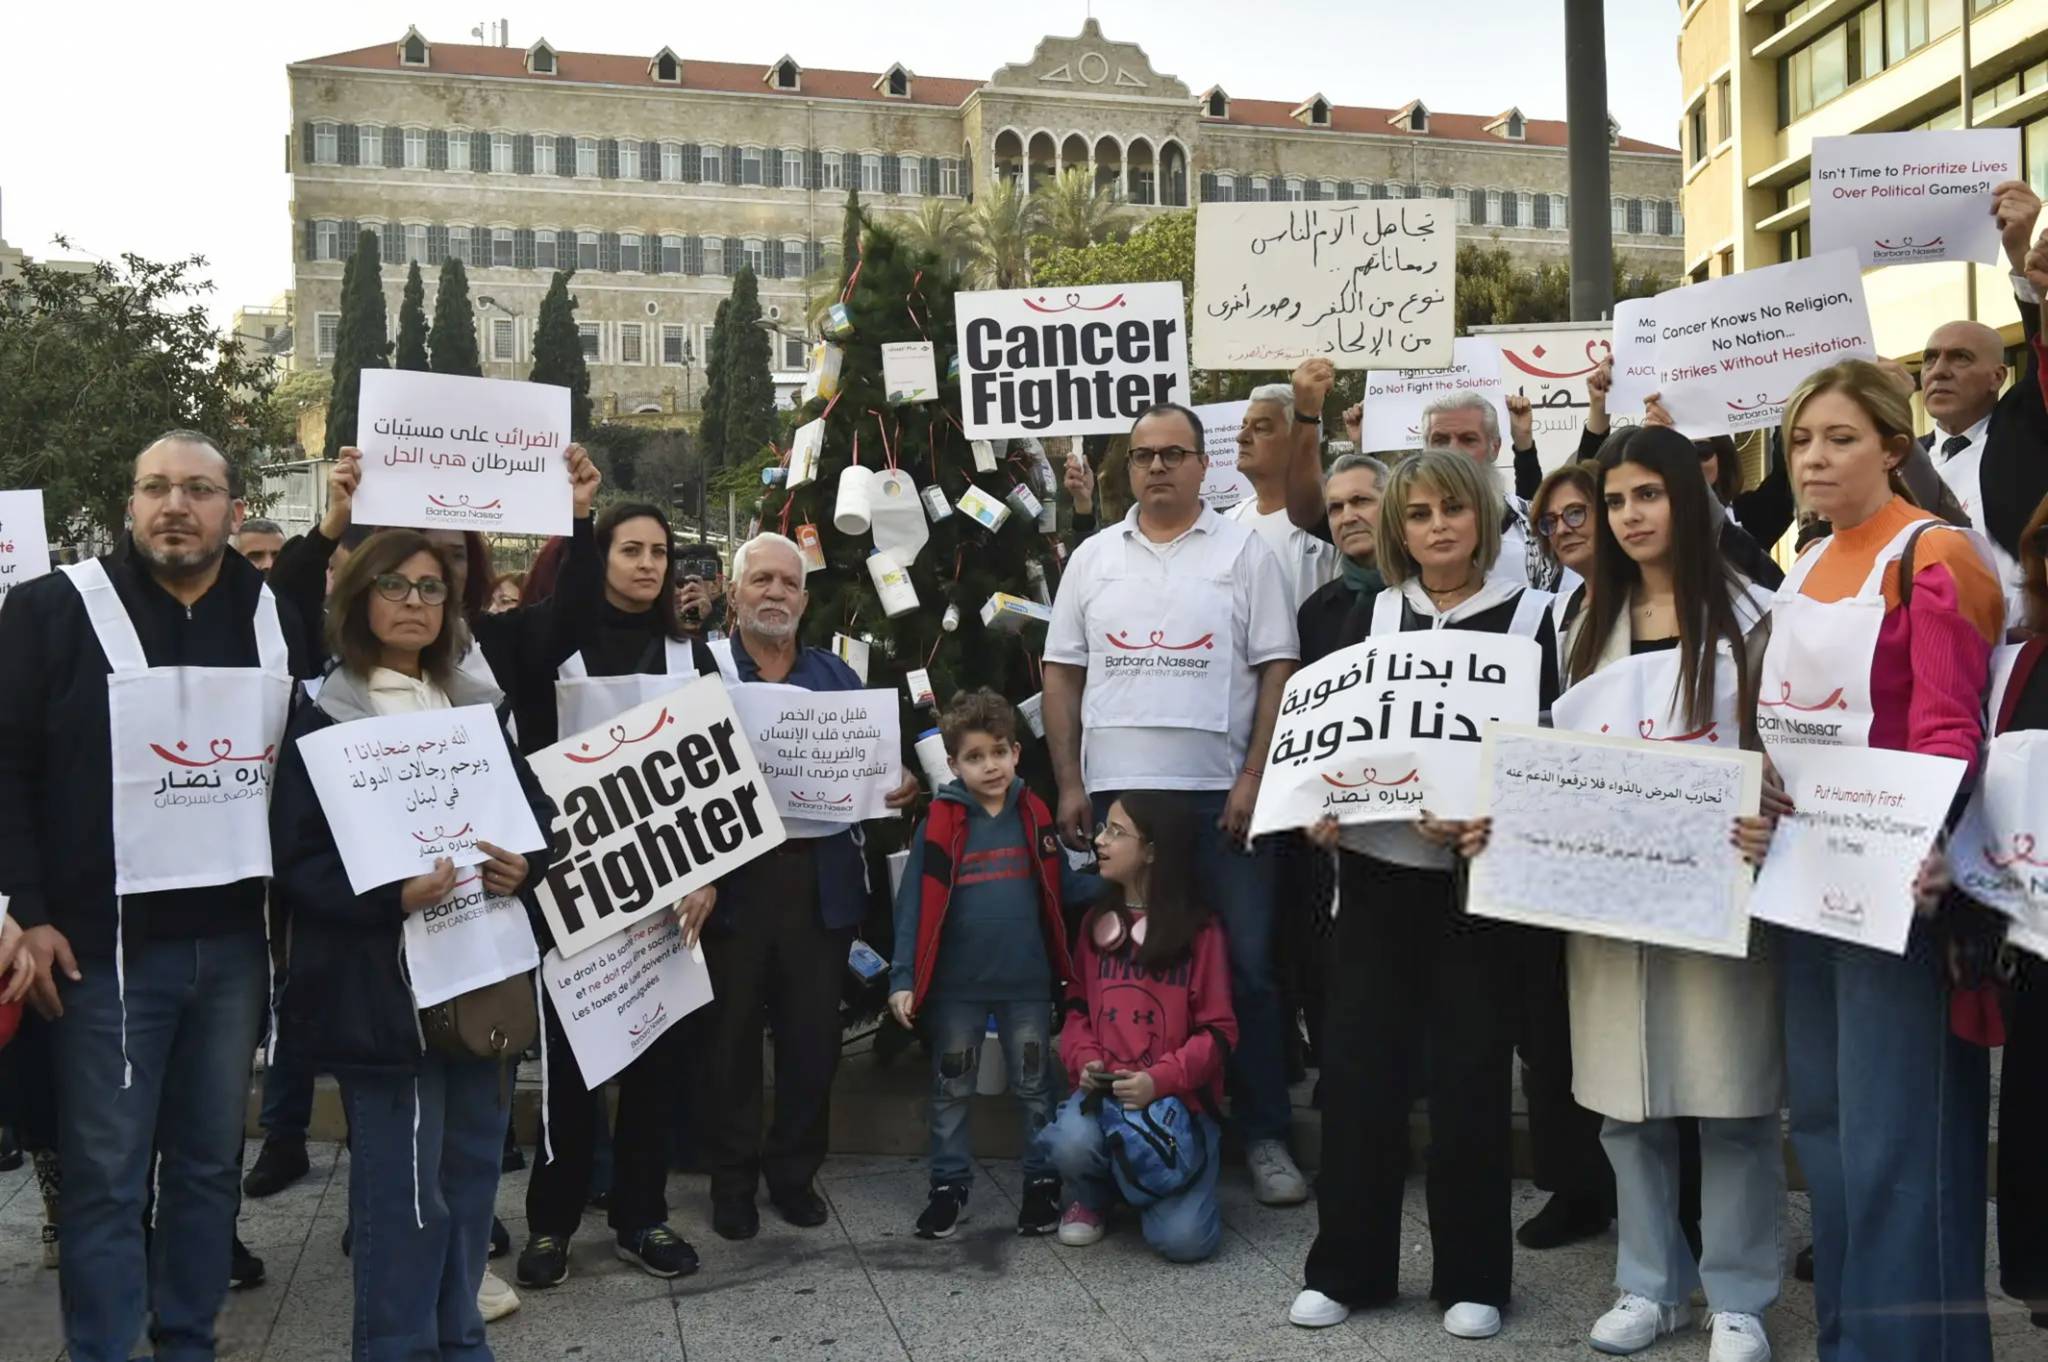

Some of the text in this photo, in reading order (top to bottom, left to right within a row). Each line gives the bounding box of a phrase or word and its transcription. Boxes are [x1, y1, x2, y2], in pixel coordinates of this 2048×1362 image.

[1818, 160, 2008, 180] Isn't Time to Prioritize Lives
[1832, 181, 1990, 199] Over Political Games?!
[1363, 207, 1436, 246] تجاهل
[1873, 246, 1946, 259] Barbara Nassar
[1353, 247, 1437, 291] ومعاناتهم
[1207, 283, 1250, 321] أخرى
[1302, 279, 1363, 327] الكفر
[1369, 294, 1395, 318] من
[1398, 288, 1445, 323] نوع
[1662, 291, 1853, 341] Cancer Knows No Religion,
[966, 317, 1177, 371] Cancer
[1401, 332, 1431, 353] من
[1712, 337, 1732, 352] No
[1660, 334, 1867, 384] It Strikes Without Hesitation.
[1369, 378, 1502, 395] Do Not Fight the Solution!
[971, 368, 1177, 430] Fighter
[1727, 406, 1769, 424] Barbara
[450, 425, 489, 443] على
[495, 427, 559, 451] الضرائب
[384, 445, 546, 475] السرطان هي الحل
[425, 506, 504, 519] Barbara Nassar
[1105, 655, 1210, 669] Barbara Nassar
[1282, 648, 1506, 717] ما بدنا أضوية
[777, 707, 867, 725] قليل من الخمر
[451, 724, 471, 746] الله
[760, 725, 881, 744] يشفي قلب الإنسان
[1271, 690, 1499, 767] دنا أدوية
[1785, 718, 1842, 737] Nassar
[355, 740, 411, 761] ضحايانا
[416, 738, 448, 760] يرحم
[777, 748, 866, 764] والضريبة عليه
[351, 758, 490, 791] ويرحم رجالات الدولة
[759, 763, 888, 783] تشفي مرضى السرطا
[1506, 768, 1523, 779] عنه
[1556, 774, 1588, 793] ترفعوا
[1590, 777, 1606, 790] فلا
[406, 783, 460, 812] في لبنان
[1645, 787, 1683, 801] المرض
[1814, 784, 1905, 808] Put Humanity First:
[545, 779, 765, 935] Fighter
[426, 921, 447, 935] FOR
[558, 978, 572, 990] Le
[573, 962, 597, 982] droit
[599, 954, 607, 968] à
[607, 951, 617, 962] la
[634, 929, 646, 941] ne
[571, 1007, 591, 1022] Les
[591, 989, 618, 1011] taxes
[618, 982, 629, 995] de
[641, 948, 671, 974] doivent
[575, 987, 587, 1000] et
[588, 982, 601, 994] ne
[602, 968, 621, 986] doit
[620, 959, 634, 975] pas
